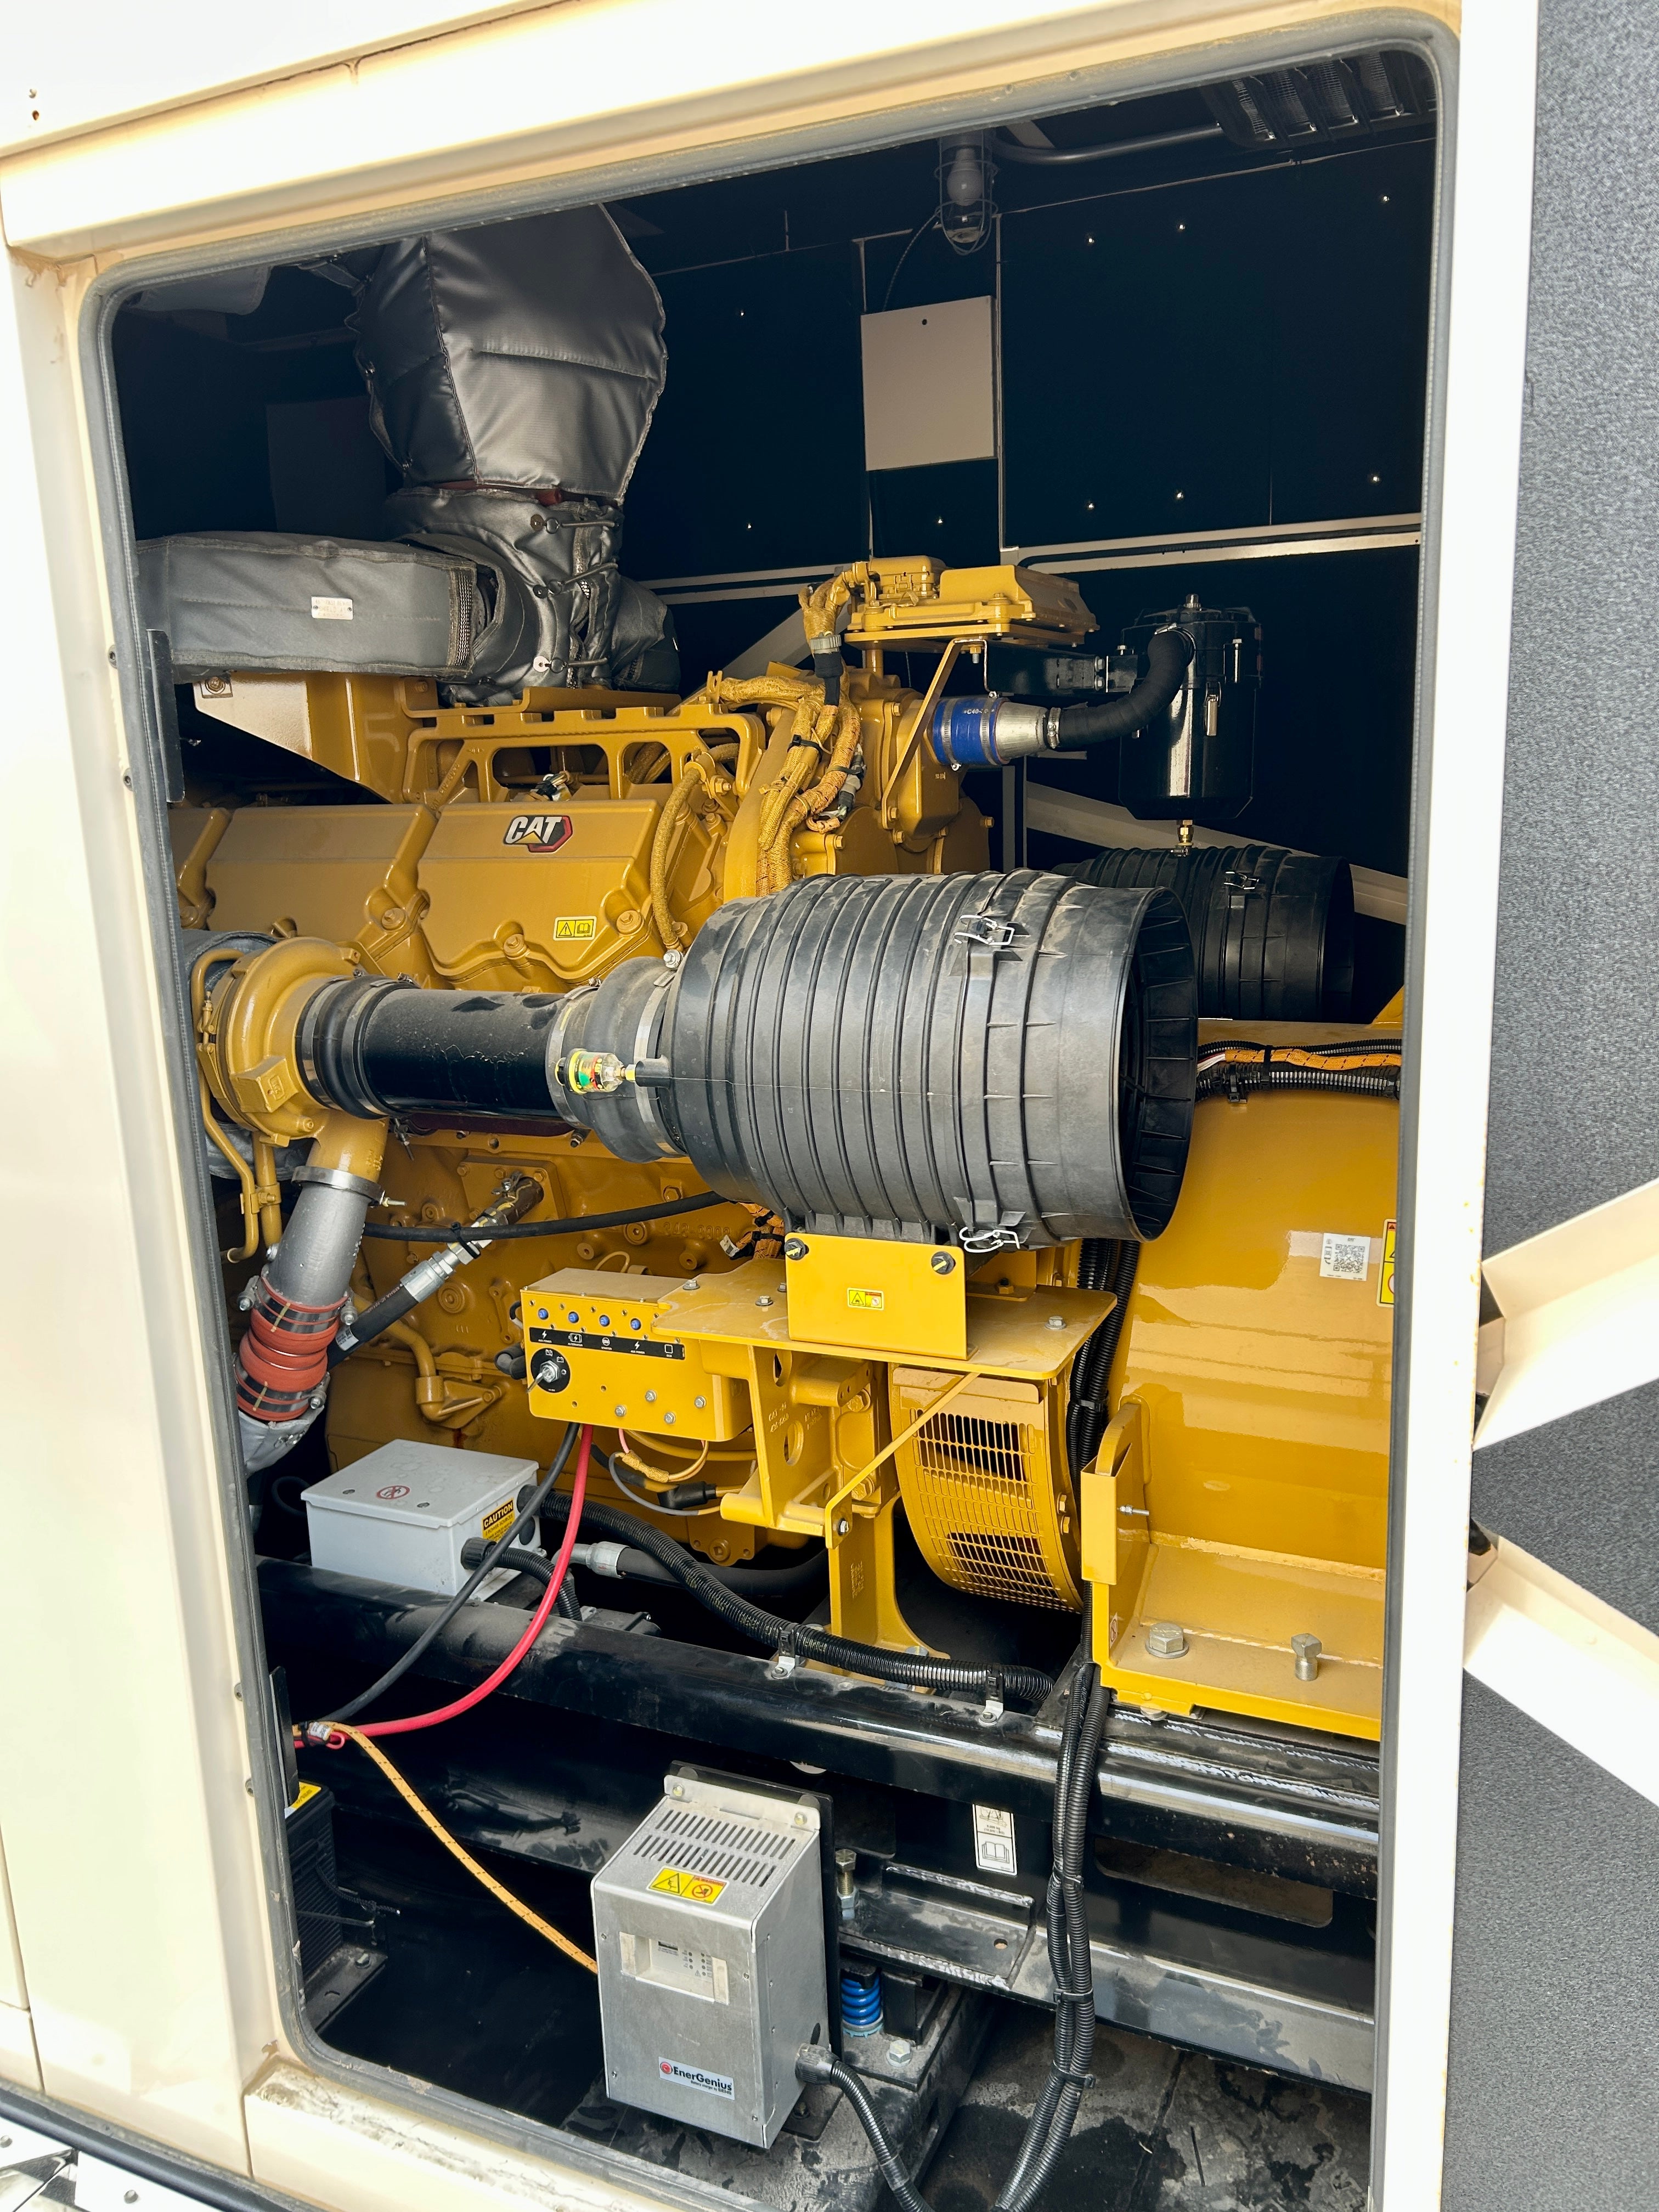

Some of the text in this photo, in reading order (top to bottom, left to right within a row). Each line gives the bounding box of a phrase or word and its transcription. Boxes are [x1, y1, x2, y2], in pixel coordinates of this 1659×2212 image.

[505, 816, 563, 844] CAT
[484, 1502, 513, 1528] CAUTION
[673, 2066, 732, 2091] EnerGenius
